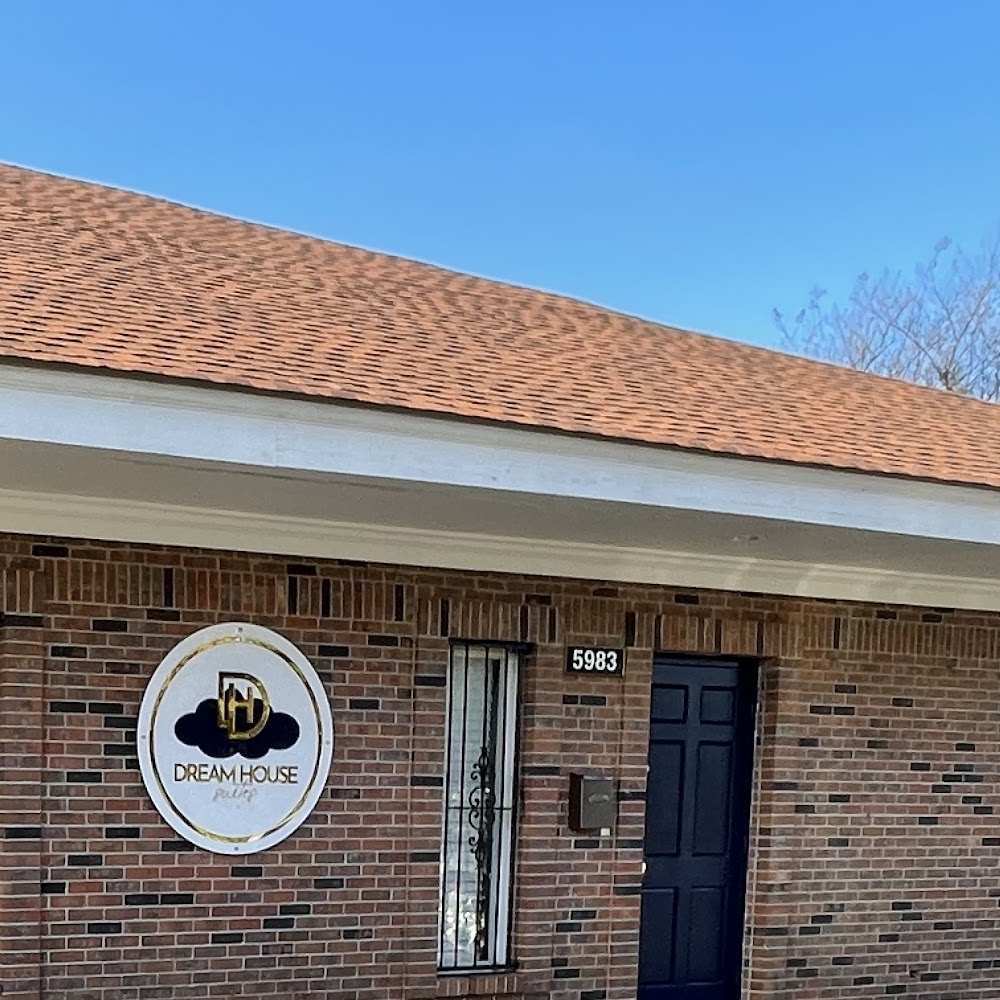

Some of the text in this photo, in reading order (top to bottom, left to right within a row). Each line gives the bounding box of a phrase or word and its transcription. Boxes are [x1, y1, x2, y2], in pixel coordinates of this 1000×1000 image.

[572, 649, 618, 671] 5983
[174, 763, 299, 784] DREAM HOUSE
